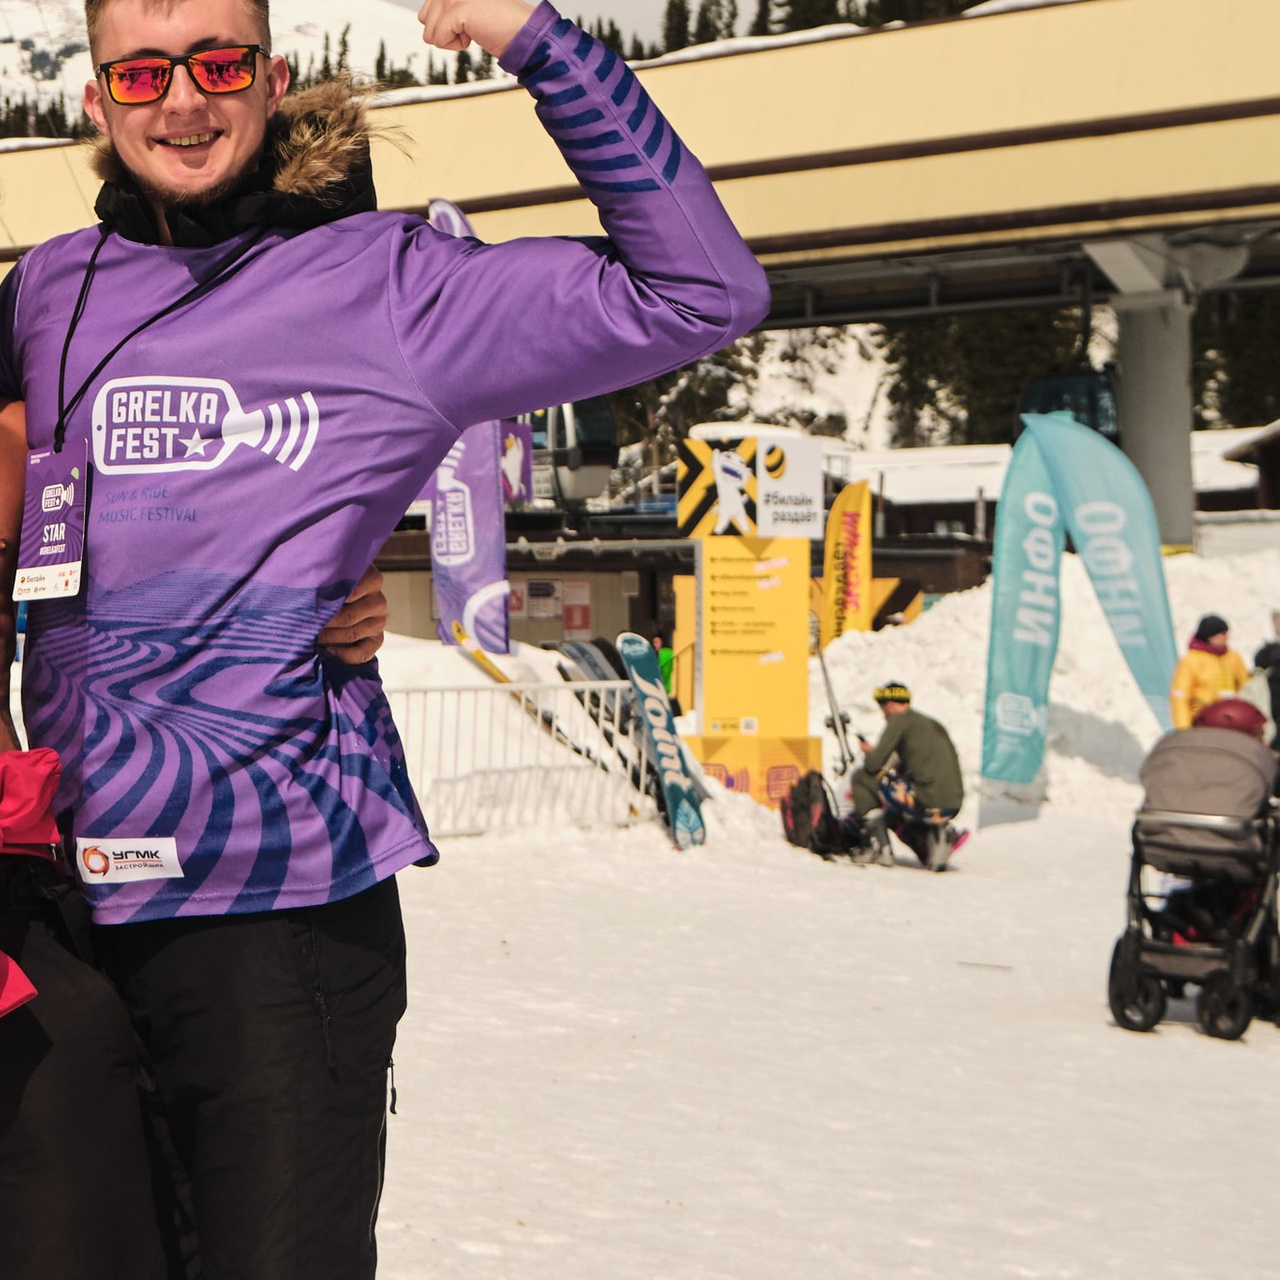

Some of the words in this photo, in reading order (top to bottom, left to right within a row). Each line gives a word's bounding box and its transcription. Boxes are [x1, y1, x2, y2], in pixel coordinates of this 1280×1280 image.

[111, 389, 219, 425] GRELKA
[109, 427, 180, 461] FEST
[105, 490, 128, 504] SUN
[142, 485, 169, 499] RIDE
[98, 507, 137, 524] MUSIC
[141, 506, 198, 523] FESTIVAL
[43, 522, 66, 543] STAR
[1013, 491, 1058, 646] ИНФО
[630, 665, 694, 792] Joint
[112, 850, 161, 860] УГМК
